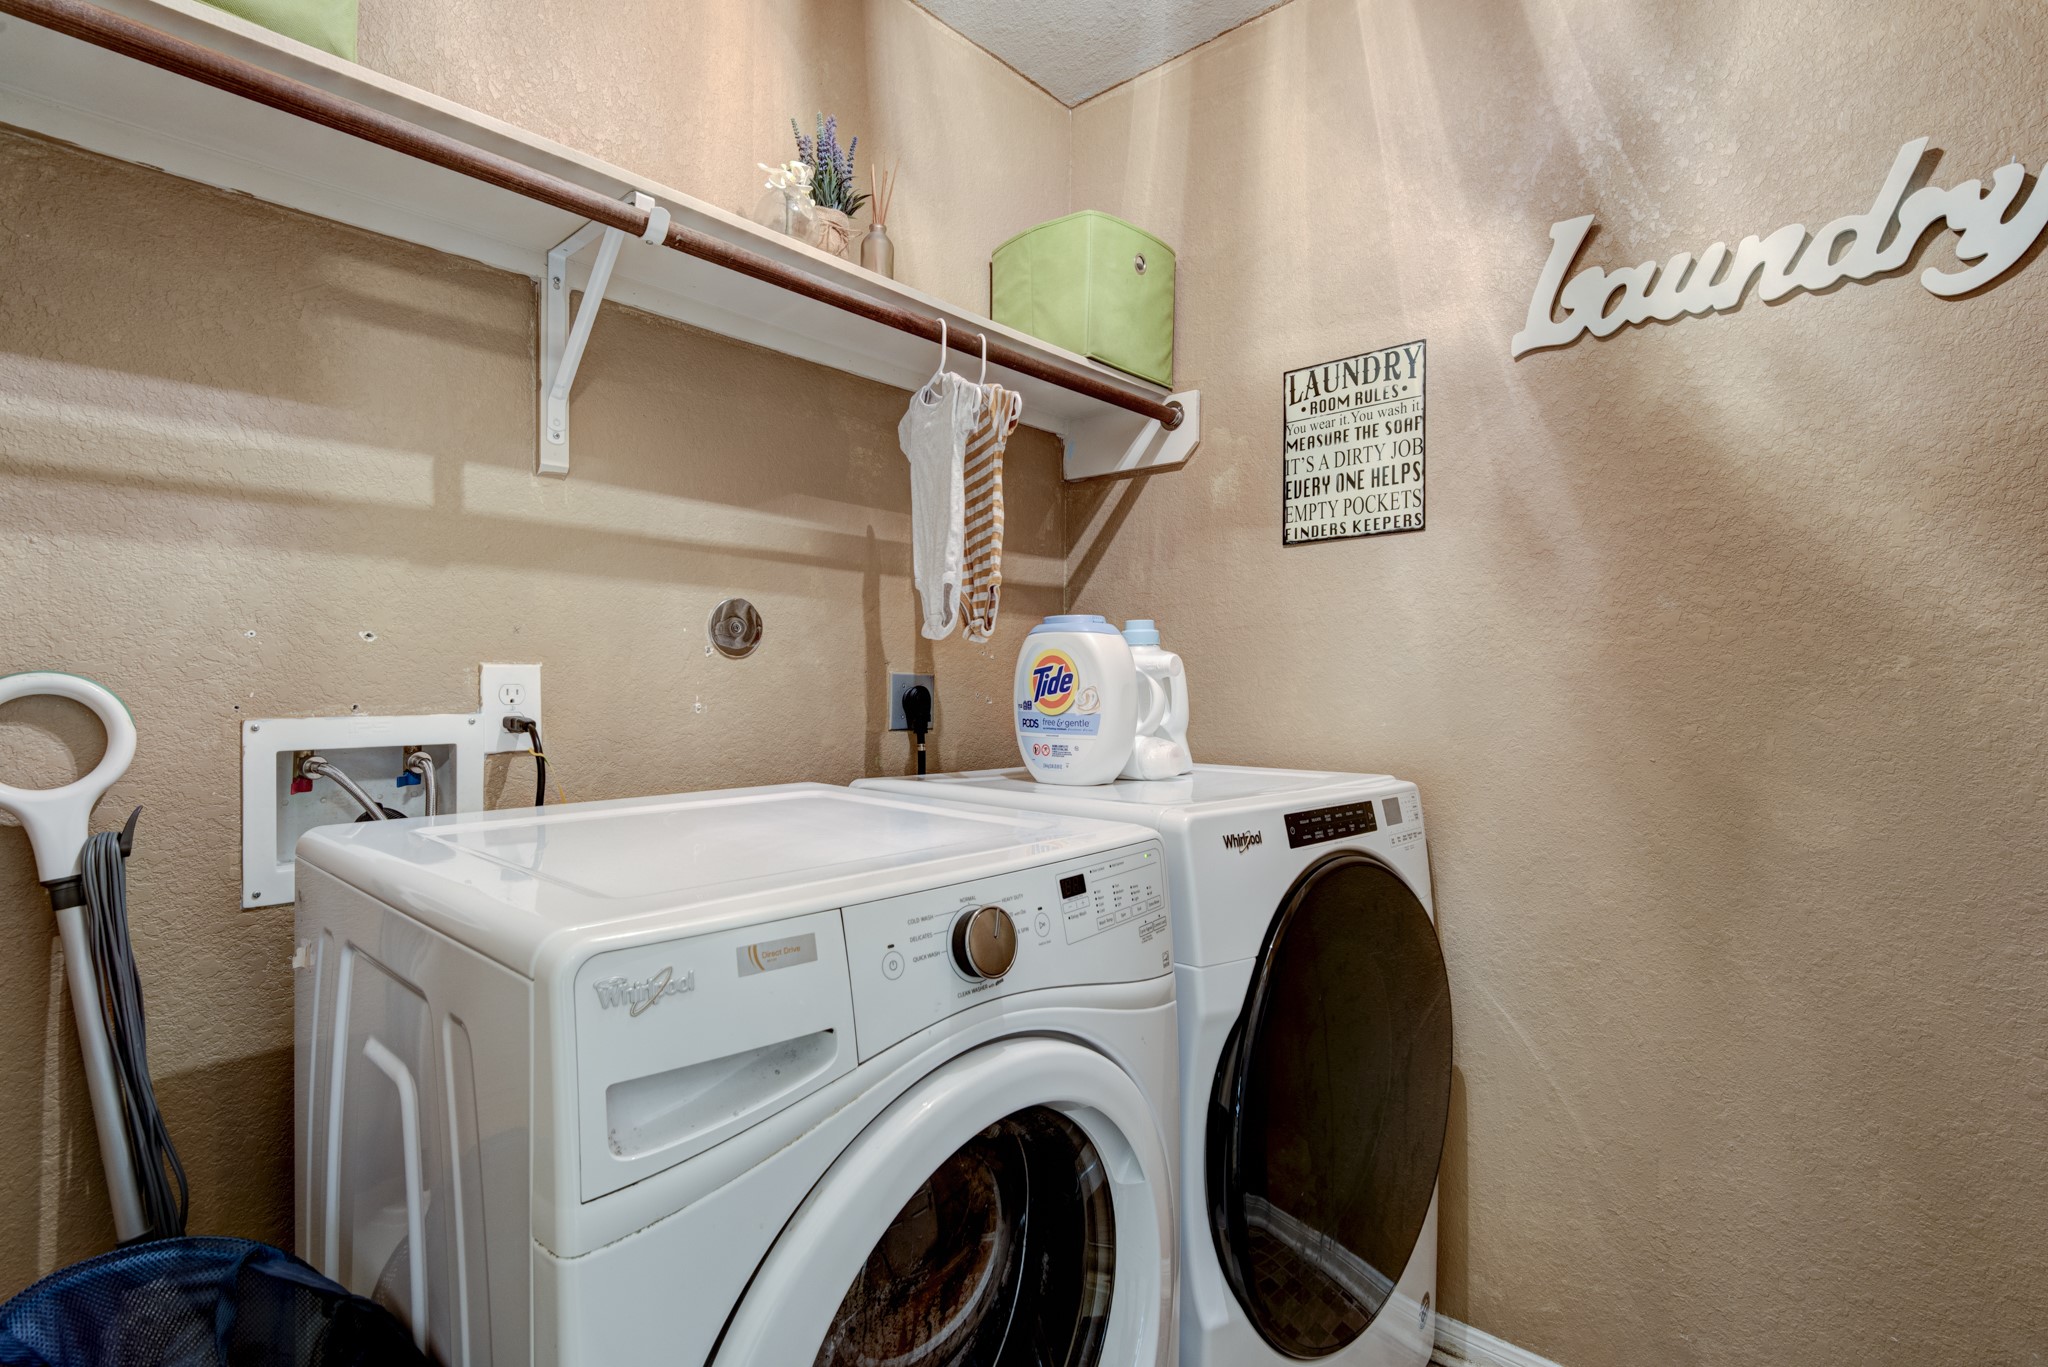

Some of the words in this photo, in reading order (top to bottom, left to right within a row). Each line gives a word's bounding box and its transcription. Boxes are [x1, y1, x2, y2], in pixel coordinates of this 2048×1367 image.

[1511, 136, 2048, 358] Laundry
[1289, 345, 1422, 406] LAUNDRY
[1310, 394, 1350, 415] ROOM
[1355, 384, 1399, 406] RULES
[1286, 425, 1306, 436] You
[1310, 418, 1336, 431] wear
[1340, 414, 1350, 426] it.
[1351, 411, 1373, 423] You
[1377, 402, 1407, 418] wash
[1286, 429, 1350, 454] MEASURE
[1355, 423, 1379, 440] THE
[1318, 454, 1329, 471] A
[1334, 443, 1386, 468] DIRTY
[1391, 437, 1423, 459] JOB
[1286, 475, 1330, 500] EVERY
[1336, 469, 1365, 493] ONE
[1371, 461, 1421, 488] HELPS
[1285, 500, 1338, 524] EMPTY
[1343, 488, 1422, 516] POCKETS
[1285, 522, 1346, 540] FINDERS
[1353, 513, 1422, 533] KEEPERS
[1033, 665, 1074, 703] Tide
[1022, 718, 1039, 728] PODS
[1042, 718, 1056, 726] free
[1064, 719, 1090, 729] gentle
[1222, 830, 1262, 850] Whirlpool
[761, 949, 782, 960] Direct
[783, 946, 801, 955] Drive
[909, 933, 933, 943] DELICATES
[912, 954, 927, 963] QUICK
[927, 951, 941, 960] WASH
[593, 969, 695, 1011] Whirlpool
[957, 989, 971, 999] CLEAN
[971, 984, 988, 994] WASHER
